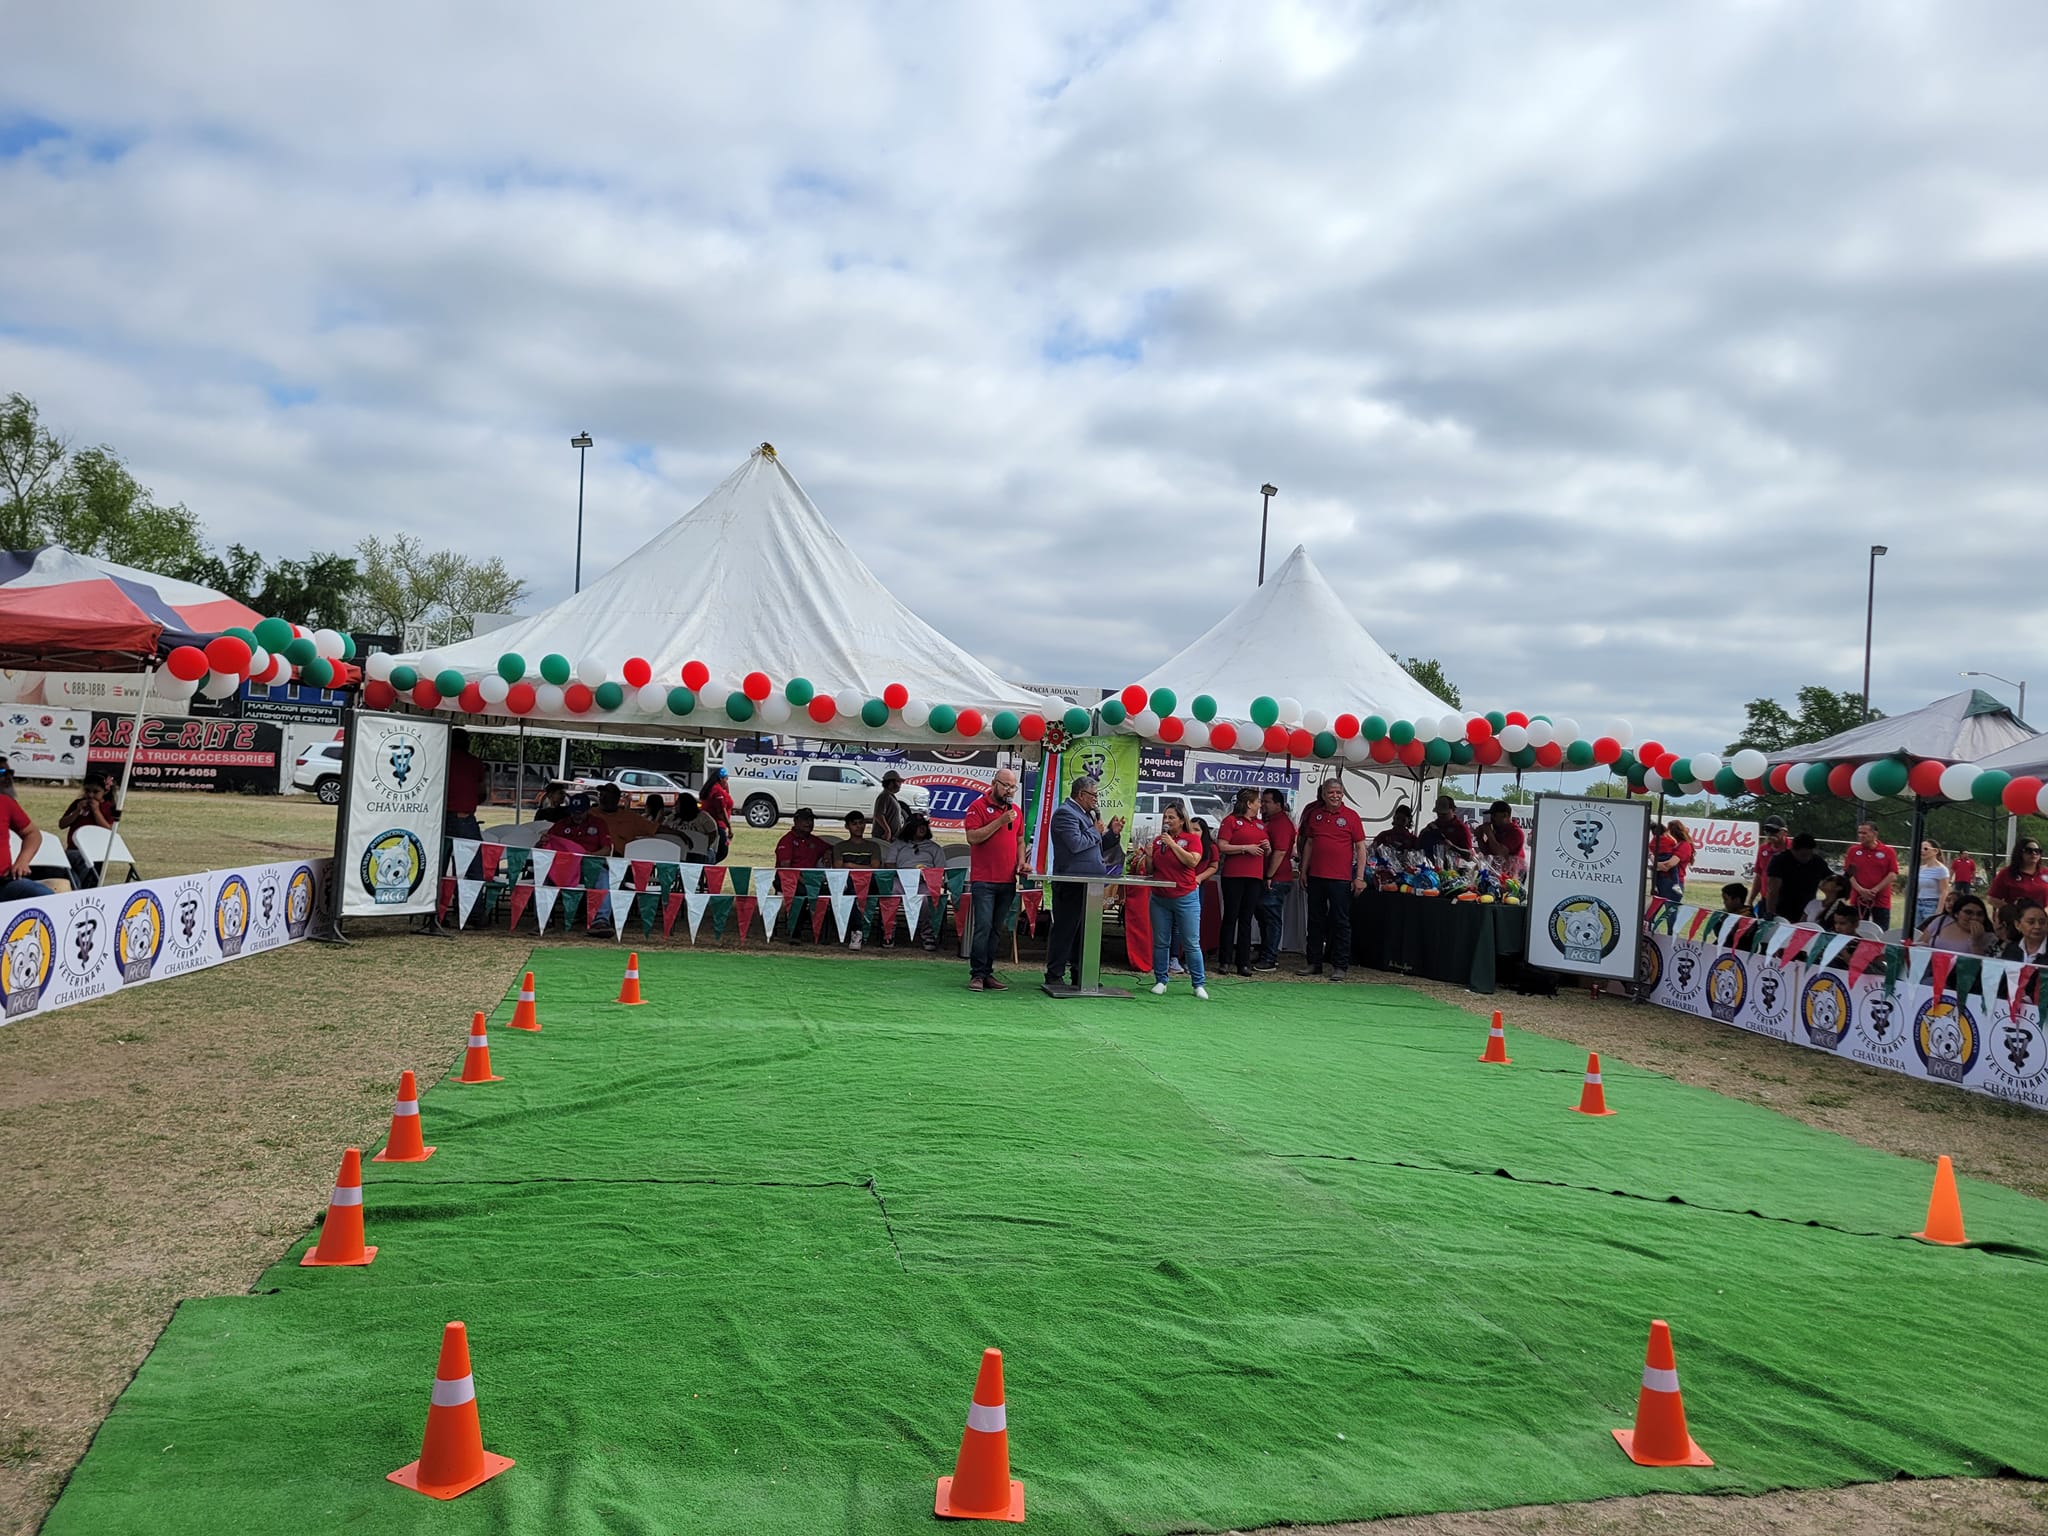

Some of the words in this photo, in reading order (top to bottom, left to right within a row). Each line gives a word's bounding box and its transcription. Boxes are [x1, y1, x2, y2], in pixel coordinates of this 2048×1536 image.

[71, 681, 106, 697] 888-1888
[1050, 687, 1080, 697] ADUANAL
[245, 711, 301, 721] AUTOMOTIVE
[302, 715, 337, 724] CENTER
[299, 706, 333, 715] BROWN
[379, 724, 423, 739] CLINICA
[89, 750, 132, 761] ELDING
[135, 751, 144, 760] &
[145, 751, 187, 762] TRUCK
[190, 752, 273, 764] ACCESSORIES
[744, 753, 798, 767] Seguros
[1143, 757, 1184, 768] paquetes
[131, 766, 162, 778] (830)
[164, 767, 217, 778] 774-6058
[734, 766, 769, 780] Vida,
[885, 761, 945, 774] APOYANDO
[945, 766, 955, 775] A
[1151, 768, 1176, 778] Texas
[1215, 768, 1243, 783] (877)
[1245, 770, 1264, 783] 772
[1266, 772, 1293, 784] 8310
[371, 775, 430, 802] VETERINARIA
[366, 801, 430, 814] CHAVARRIA
[1563, 802, 1613, 817] CLINICA
[1687, 821, 1756, 850] ylake
[1555, 846, 1621, 871] VETERINARIA
[1704, 846, 1732, 855] FISHING
[1732, 848, 1754, 856] TACKLE
[1551, 868, 1623, 884] CHAVARRIA
[174, 880, 204, 898] CLINICA
[381, 891, 405, 902] RCG
[68, 896, 106, 917] CLINICA
[167, 929, 208, 959] VETERINARIA
[1570, 948, 1597, 961] RCG
[59, 951, 109, 987] VETERINARIA
[128, 962, 149, 977] RCG
[164, 955, 208, 975] CHAVARRIA
[54, 982, 106, 1005] CHAVARRIA
[1664, 977, 1702, 1001] VETERINARIA
[11, 990, 35, 1013] RCG
[1661, 996, 1699, 1014] CHAVARRIA
[1749, 1000, 1789, 1025] VETERINARIA
[1745, 1020, 1787, 1040] CHAVARRIA
[1855, 1024, 1908, 1054] VETERINARIA
[1852, 1048, 1906, 1071] CHAVARRIA
[1933, 1062, 1958, 1078] RCG
